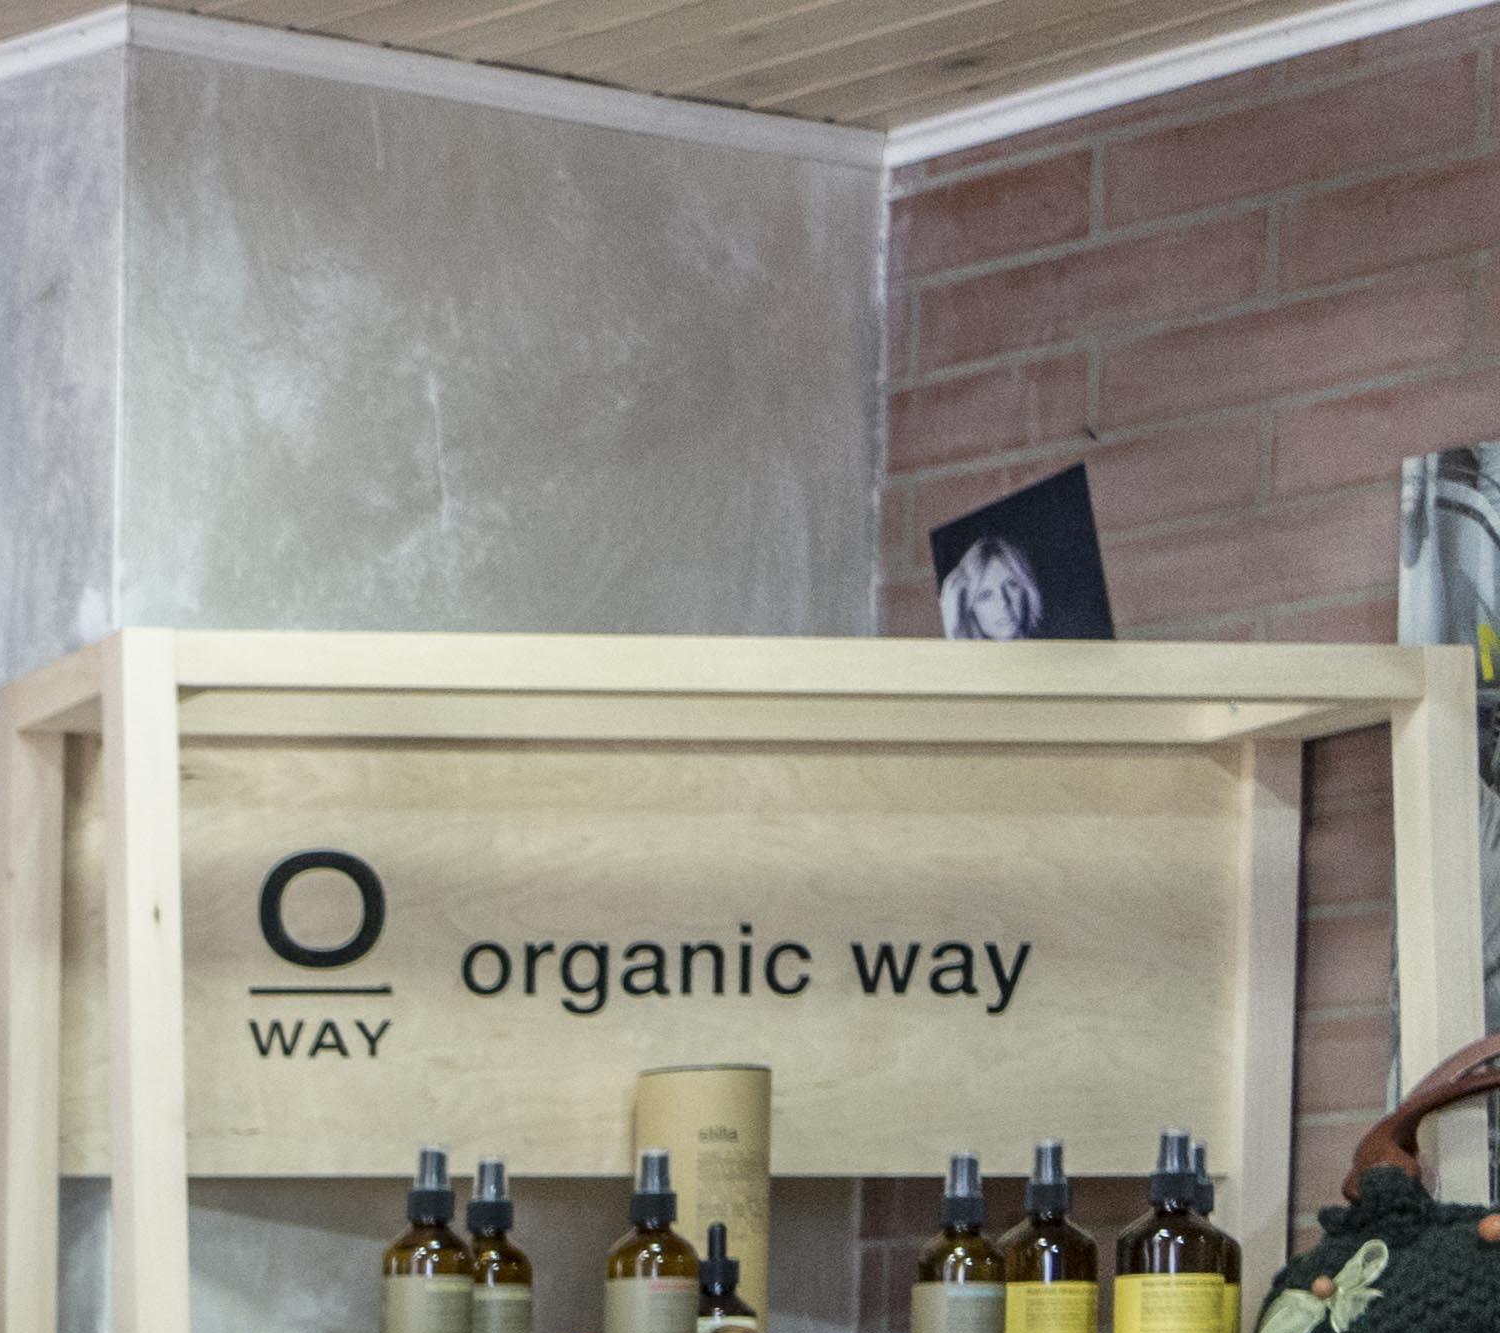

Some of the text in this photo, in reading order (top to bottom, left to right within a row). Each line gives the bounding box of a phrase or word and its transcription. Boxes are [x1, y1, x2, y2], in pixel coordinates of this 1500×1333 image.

[460, 924, 1033, 1016] organic way
[248, 1018, 393, 1059] WAY
